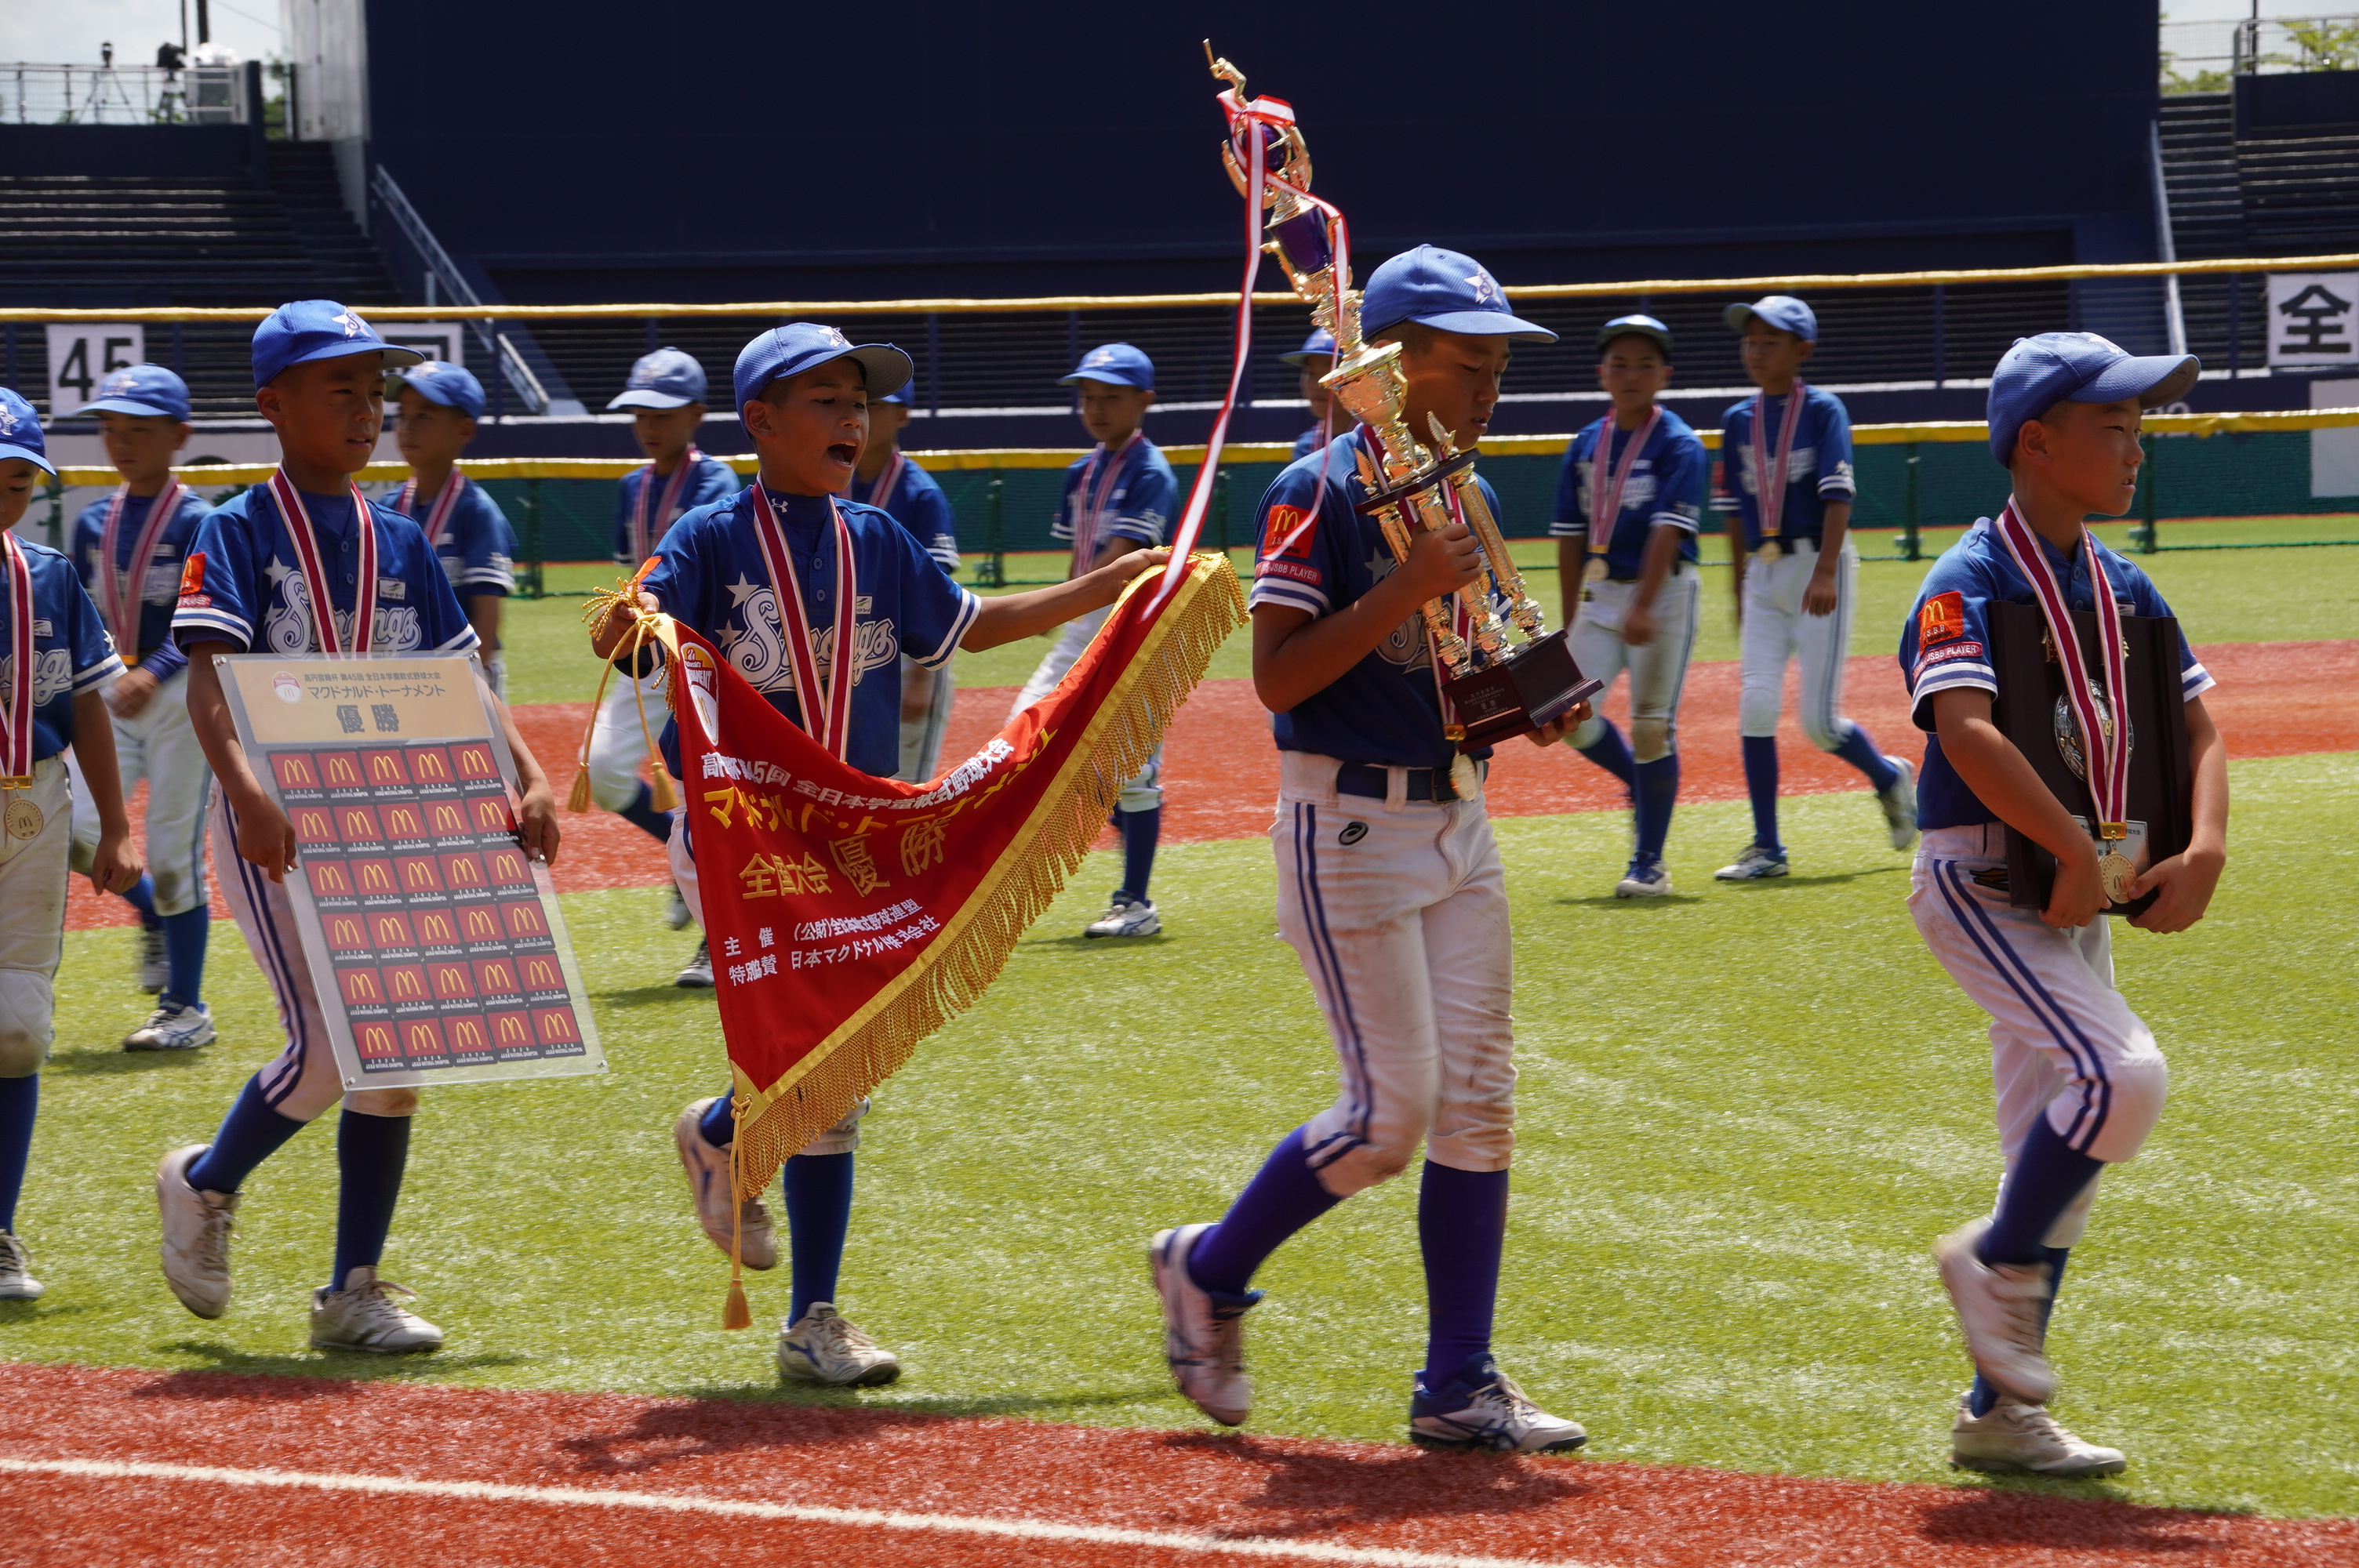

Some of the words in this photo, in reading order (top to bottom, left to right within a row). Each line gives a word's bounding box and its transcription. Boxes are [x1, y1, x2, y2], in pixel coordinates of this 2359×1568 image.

[2278, 285, 2353, 354] 全
[1289, 565, 1318, 581] PLAYER
[1946, 644, 1976, 655] PLAYER
[307, 684, 446, 699] マクドナルド・トーナメント
